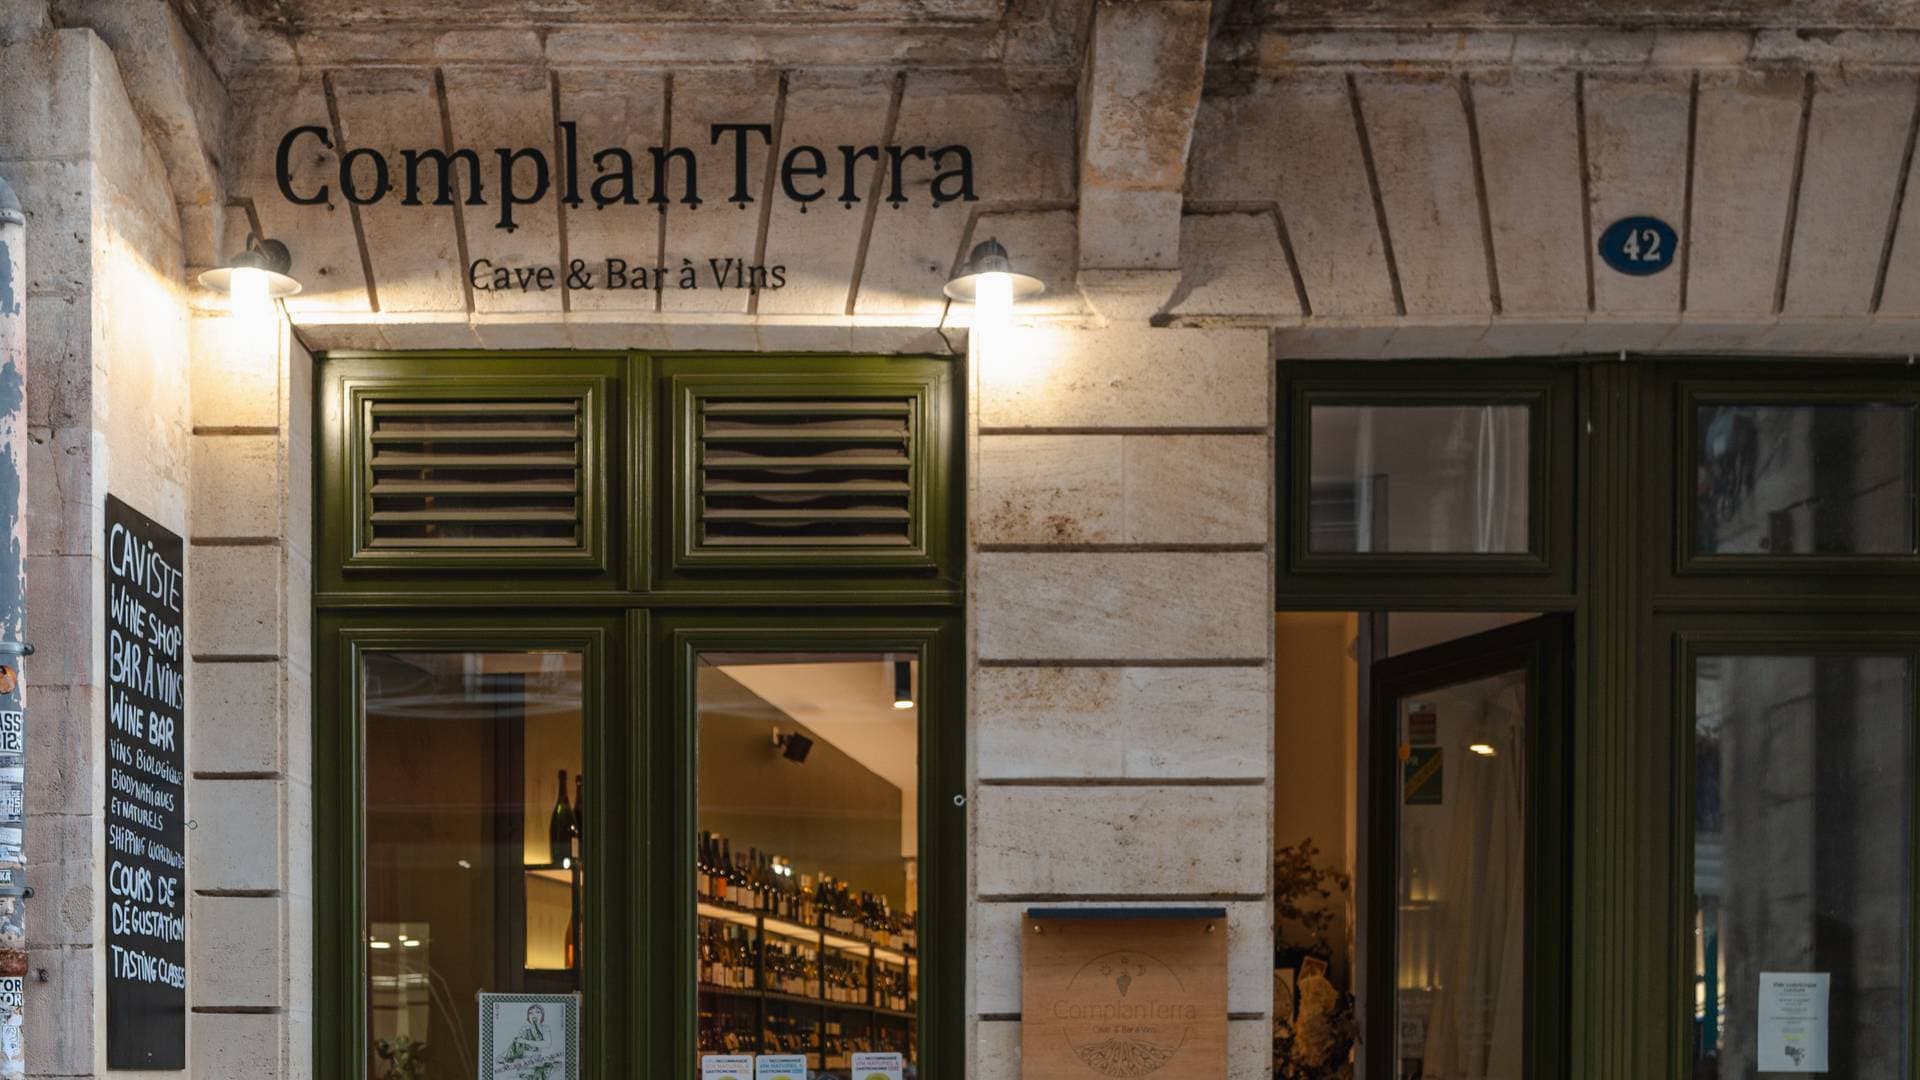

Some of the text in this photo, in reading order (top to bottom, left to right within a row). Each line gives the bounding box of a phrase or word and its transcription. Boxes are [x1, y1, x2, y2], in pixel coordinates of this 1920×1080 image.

[275, 121, 979, 229] ComplanTerra
[1623, 228, 1661, 261] 42
[469, 258, 787, 291] Cave & Bar à Vins
[148, 613, 182, 661] SHOP
[110, 629, 142, 692] BAR
[143, 647, 154, 699] À
[149, 711, 175, 753] BAR
[122, 801, 163, 831] NATURELS
[110, 860, 177, 908] COURS DE
[1053, 1000, 1197, 1024] ComplanTerra
